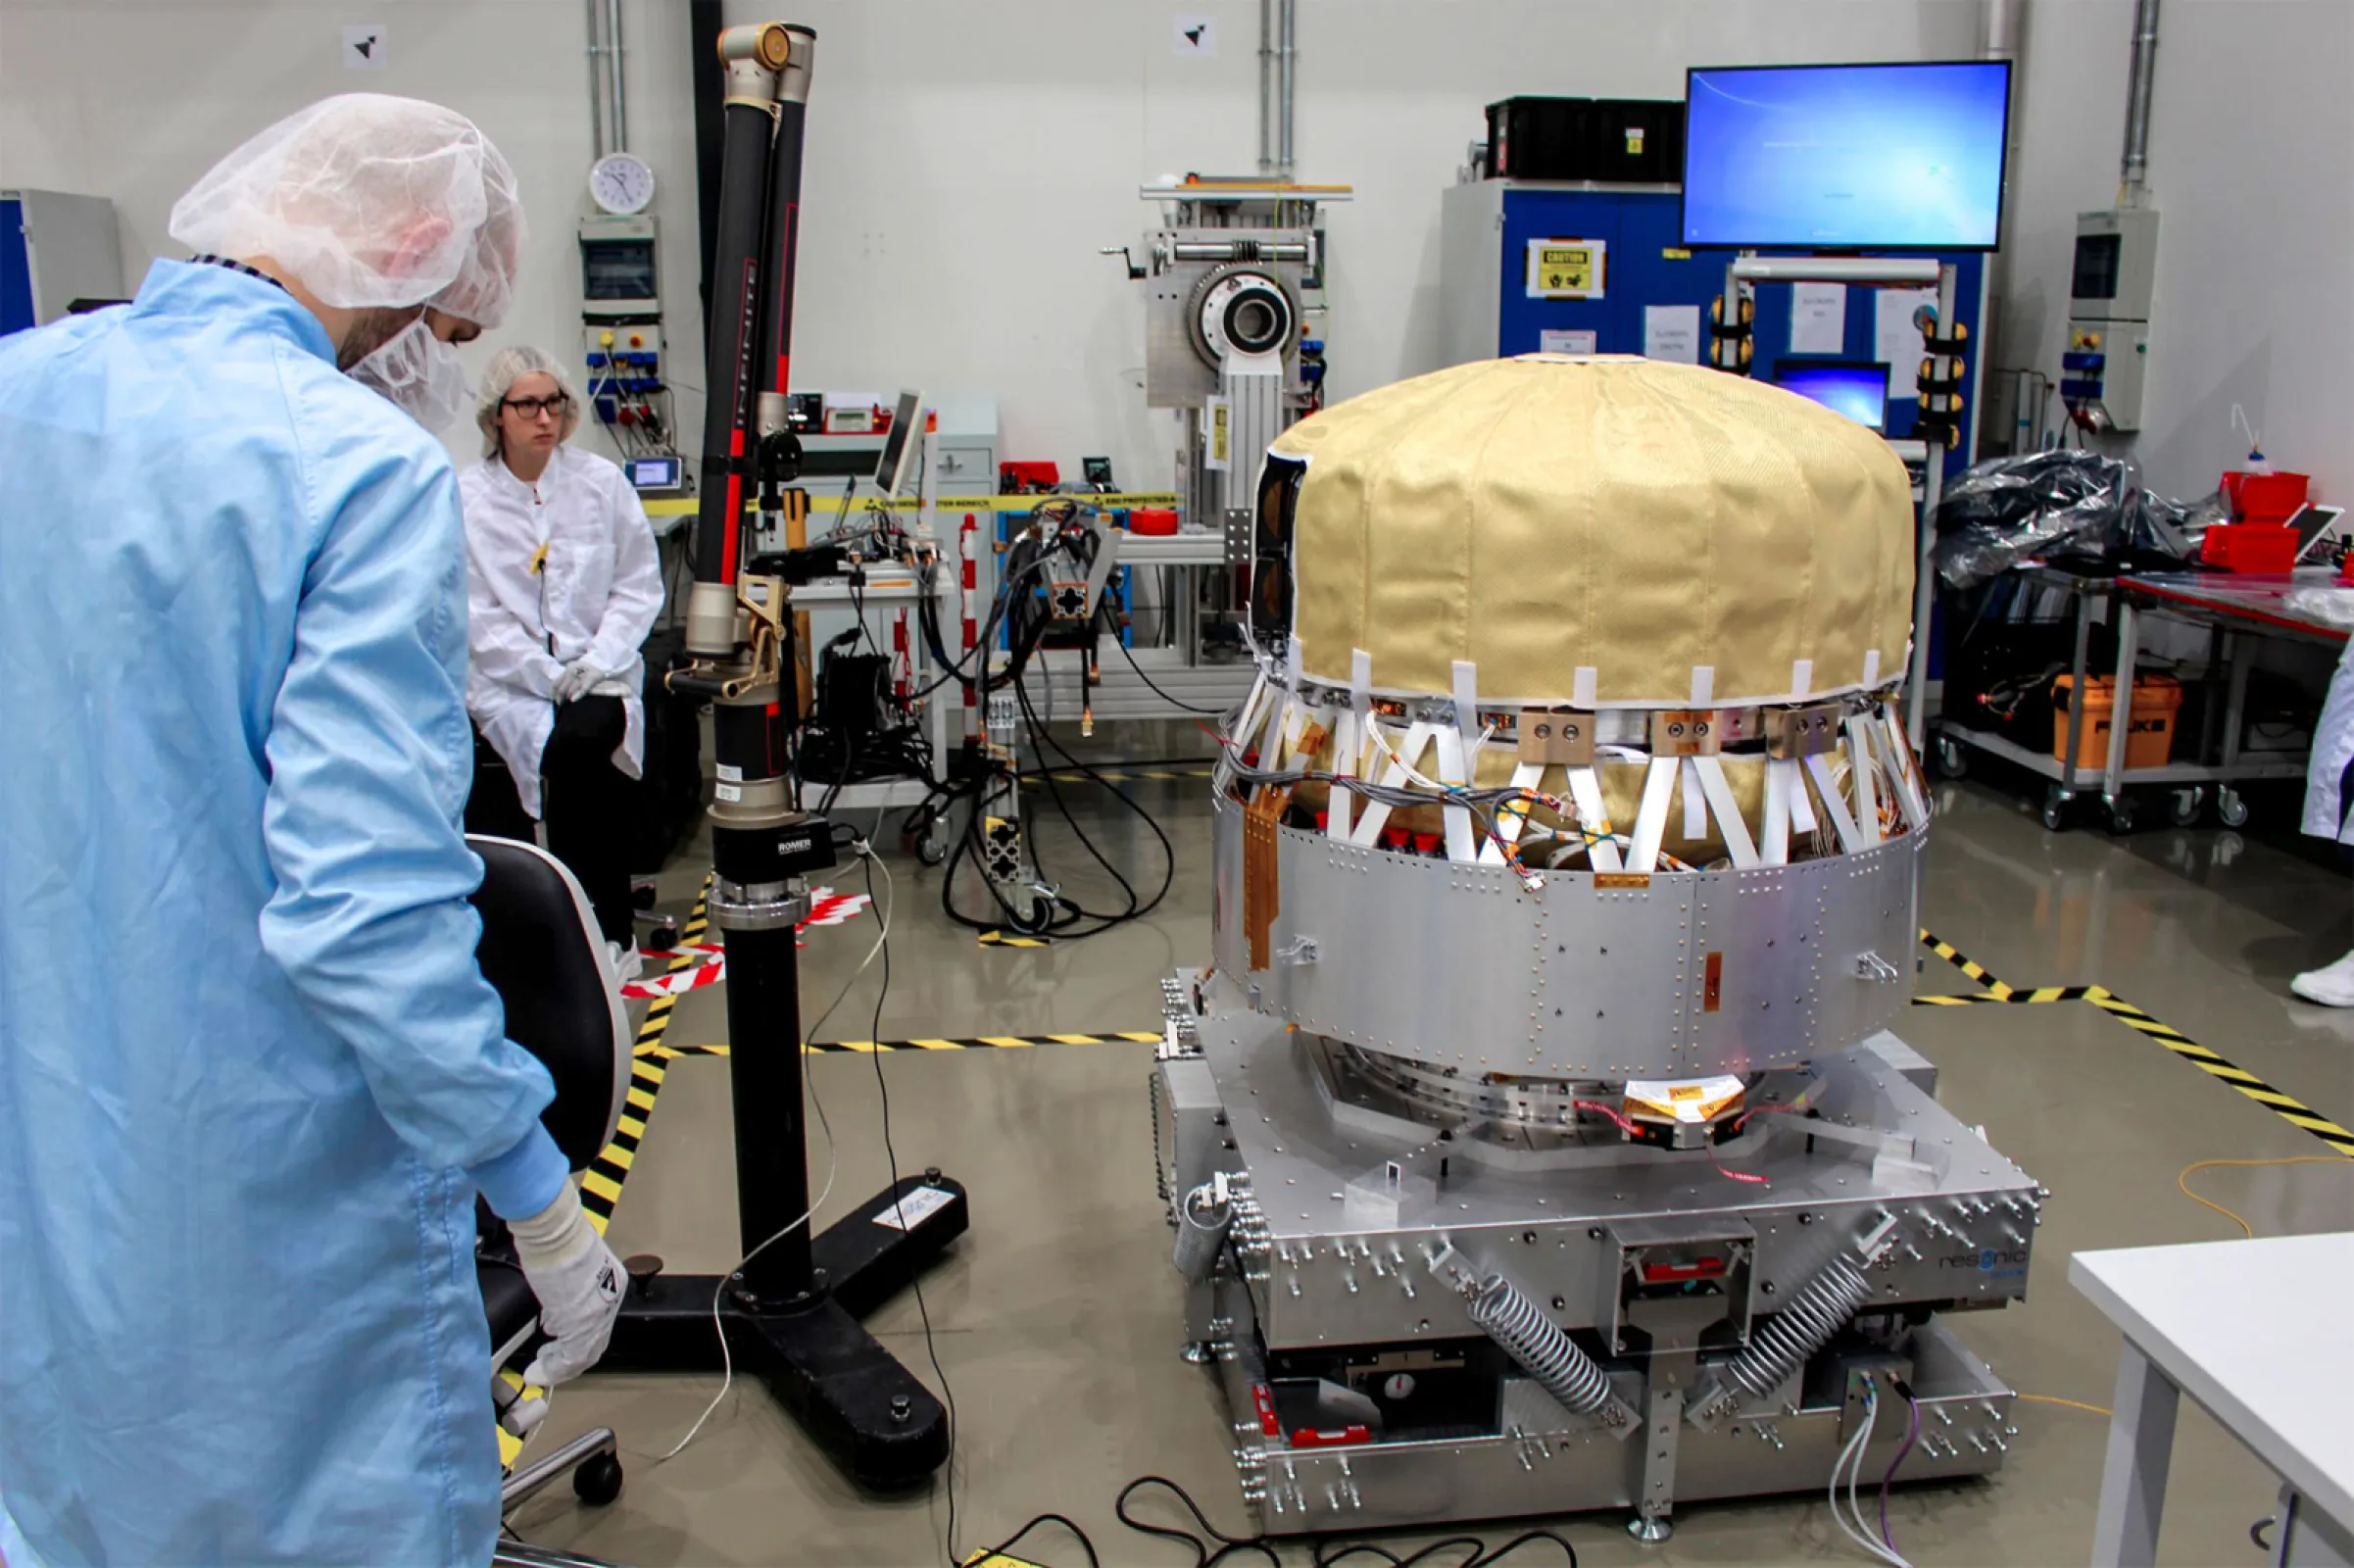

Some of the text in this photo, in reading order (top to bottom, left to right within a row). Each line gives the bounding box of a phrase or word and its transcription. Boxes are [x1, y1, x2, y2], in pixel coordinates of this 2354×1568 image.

[736, 265, 757, 426] INFINITE
[778, 839, 811, 853] ROMER
[1939, 1250, 2027, 1270] resonic
